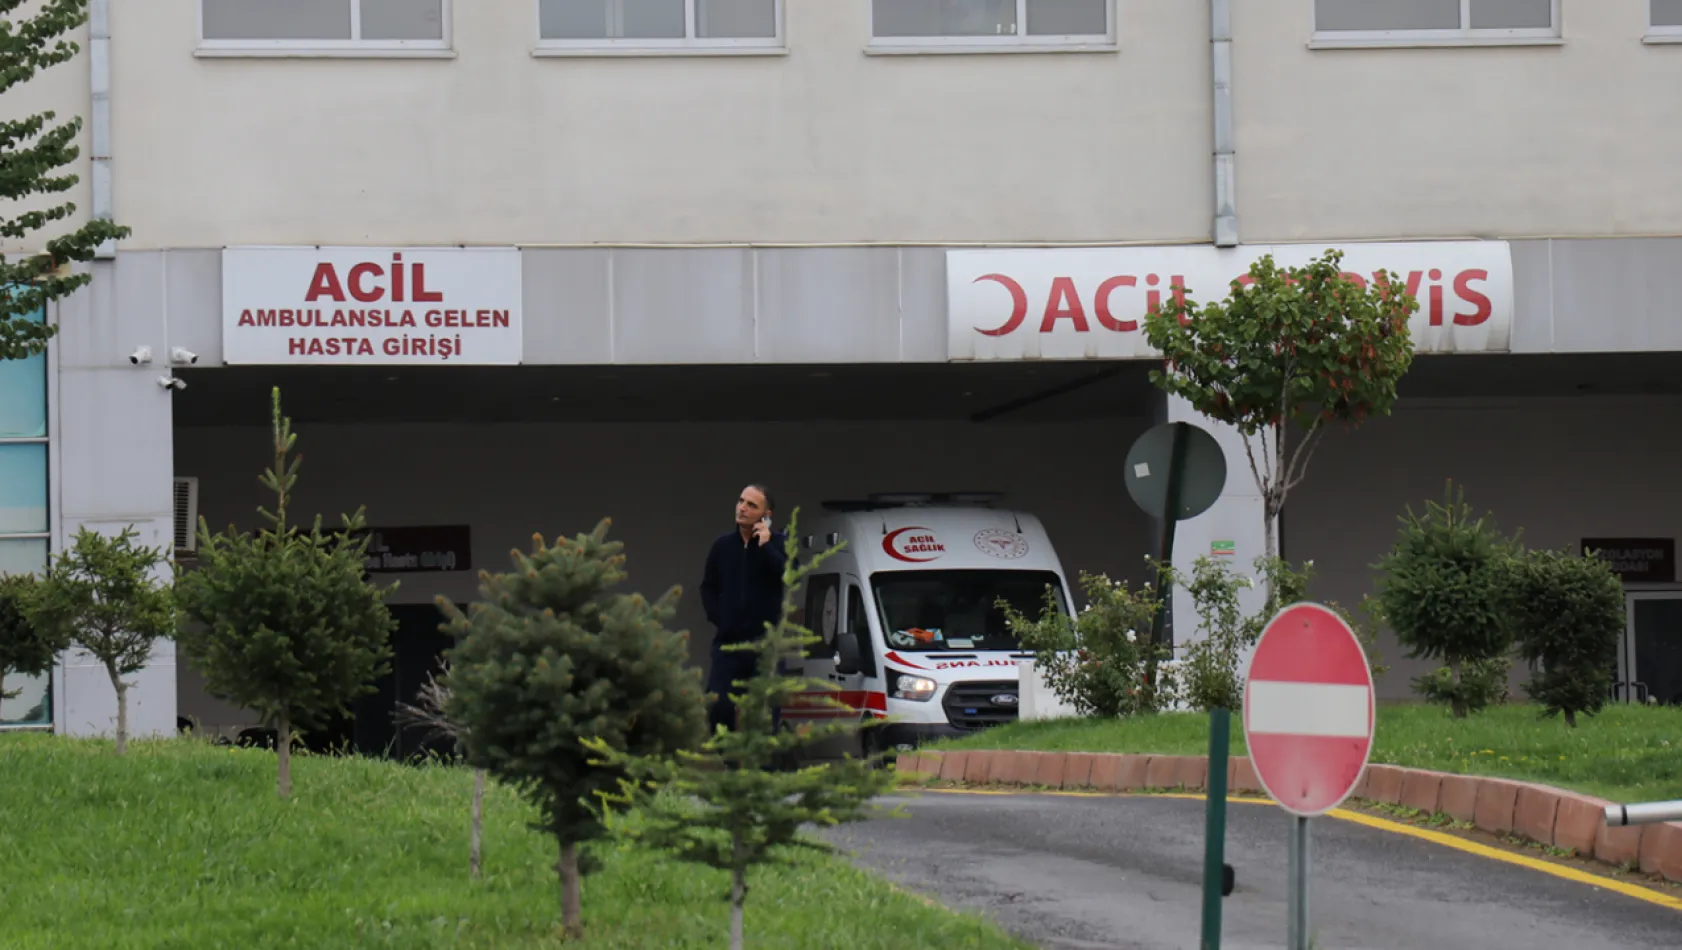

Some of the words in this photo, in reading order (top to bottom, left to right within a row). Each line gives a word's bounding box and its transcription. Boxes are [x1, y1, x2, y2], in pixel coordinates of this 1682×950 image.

[305, 252, 443, 302] ACİL
[1231, 268, 1491, 327] ViS
[238, 309, 417, 327] AMBULANSLA
[425, 309, 509, 327] GELEN
[288, 337, 374, 355] HASTA
[383, 334, 461, 360] GİRİŞİ
[904, 544, 946, 554] SAĞLIK
